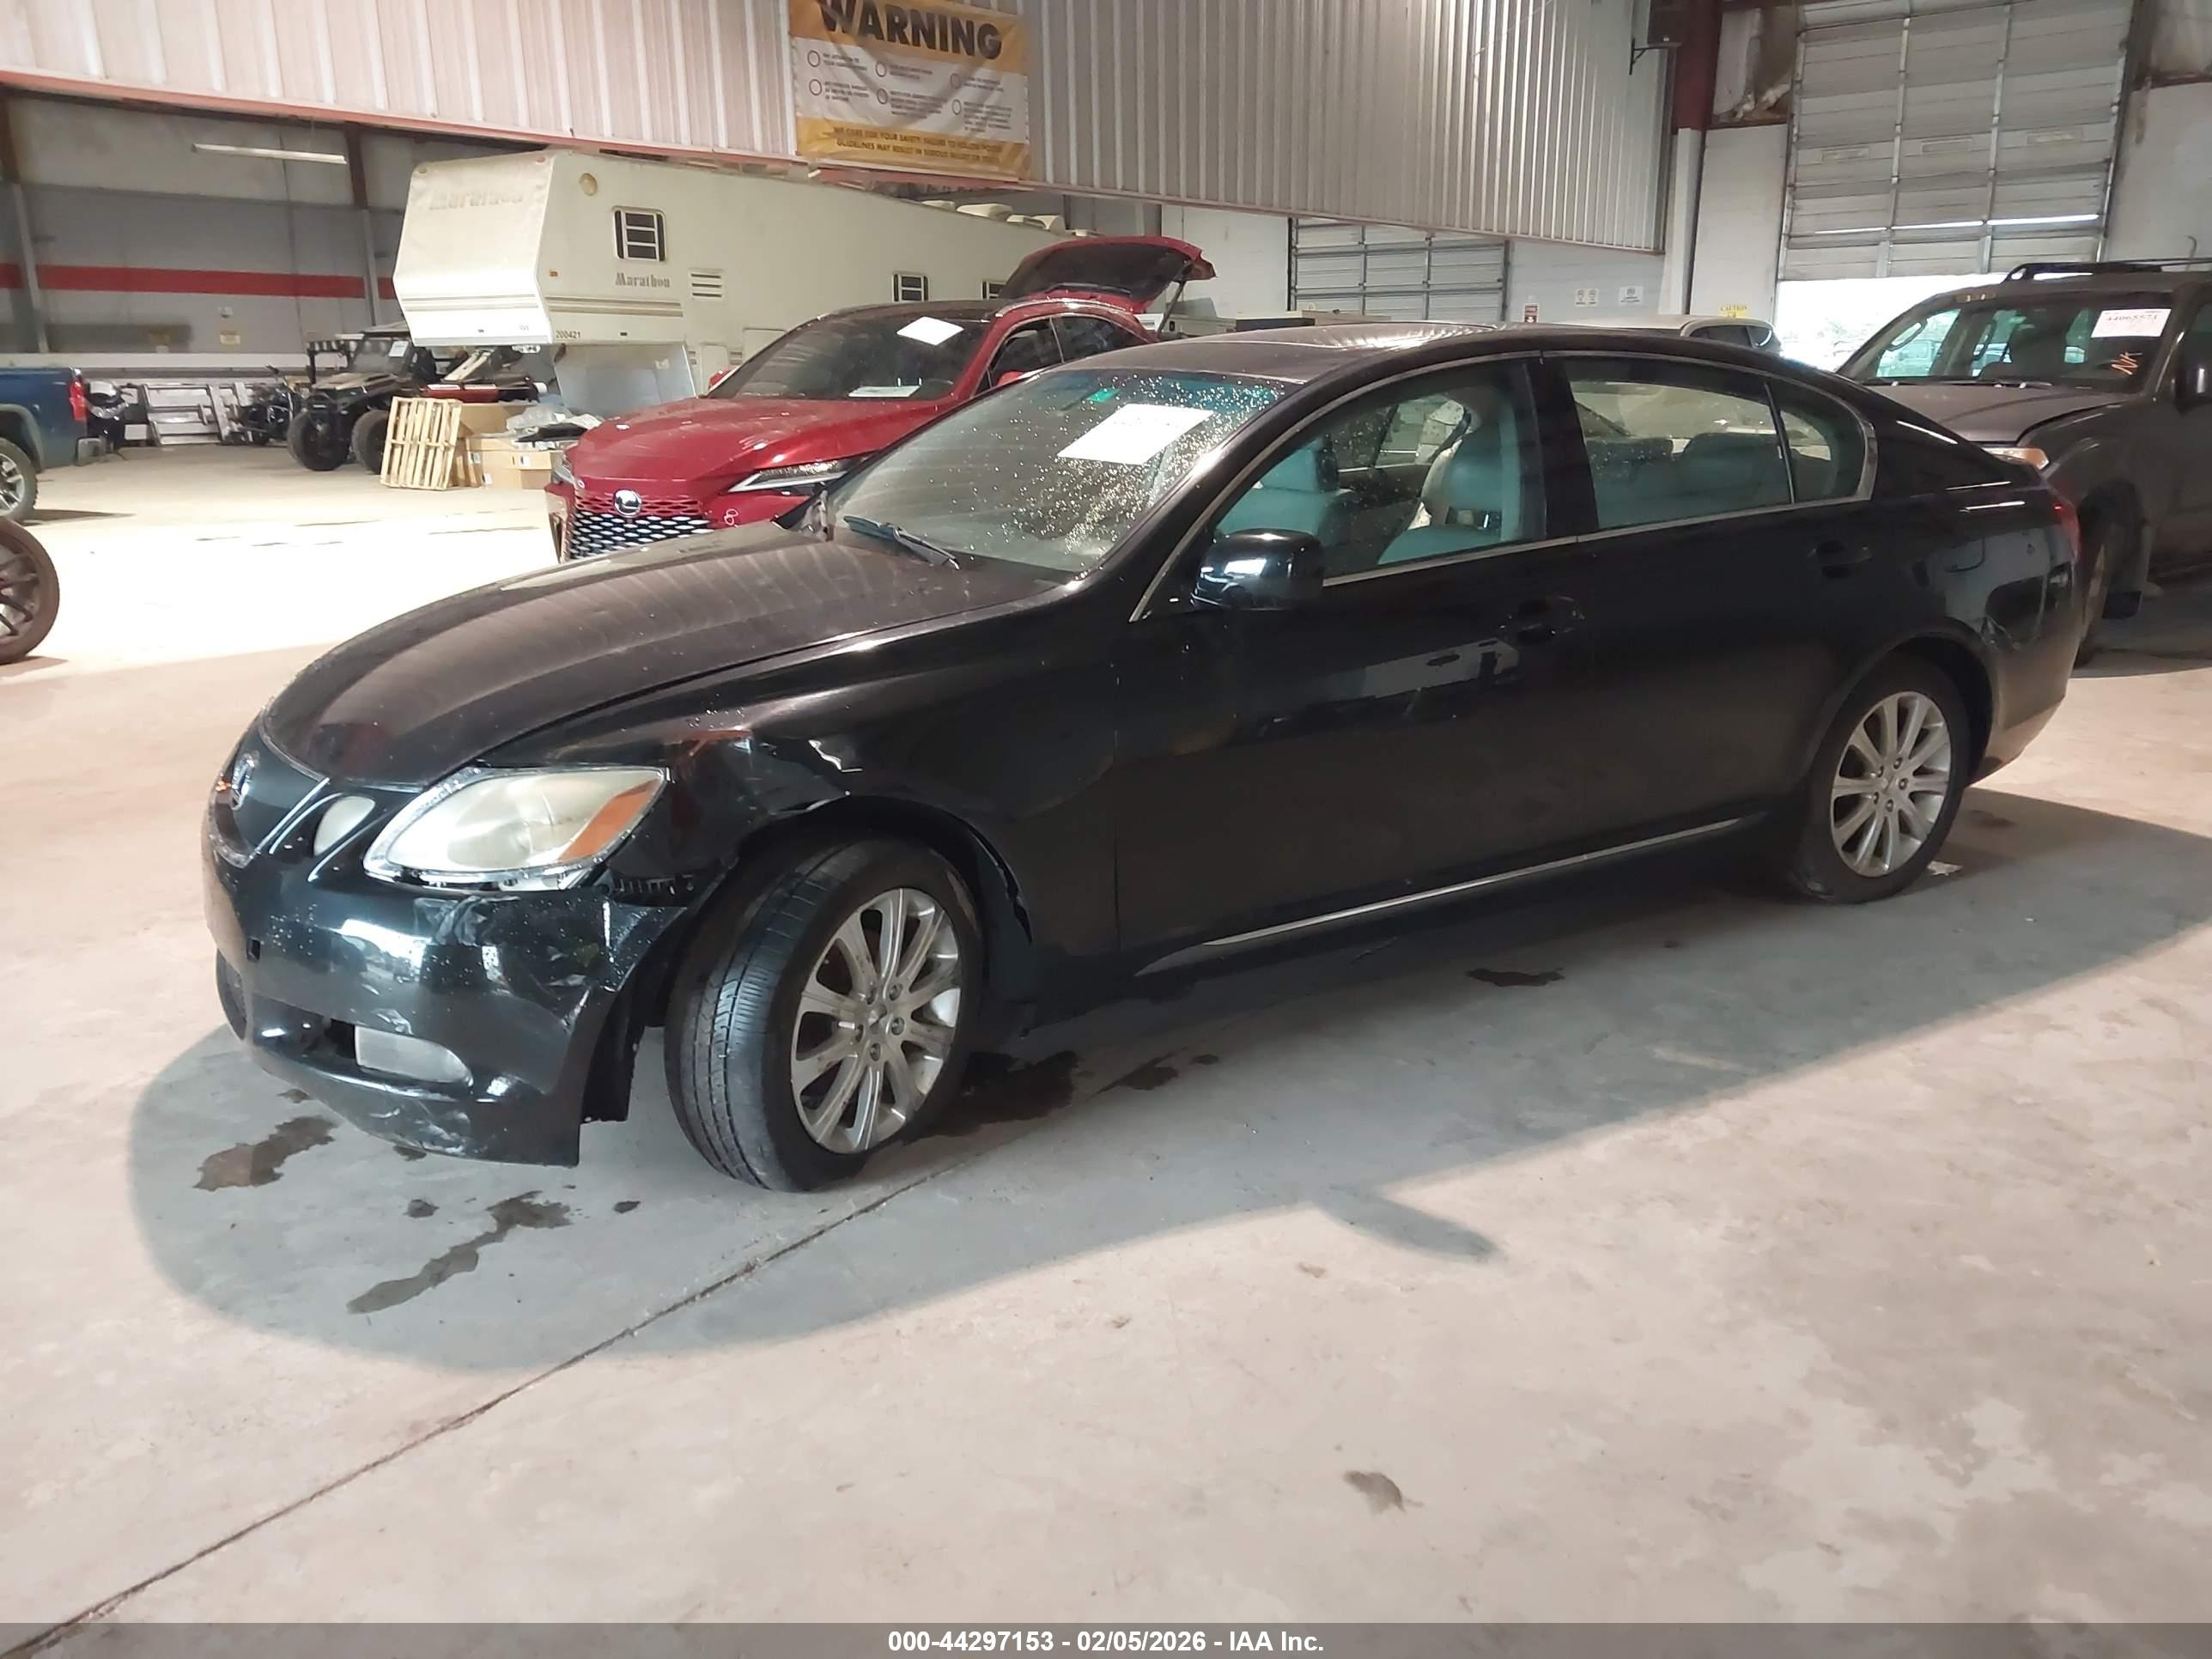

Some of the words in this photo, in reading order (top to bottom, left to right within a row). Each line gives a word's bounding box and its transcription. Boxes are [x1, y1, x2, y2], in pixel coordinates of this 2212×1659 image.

[818, 0, 1004, 60] WARNING
[877, 143, 891, 152] MAY
[615, 271, 672, 289] Marathon
[555, 329, 581, 339] 200421
